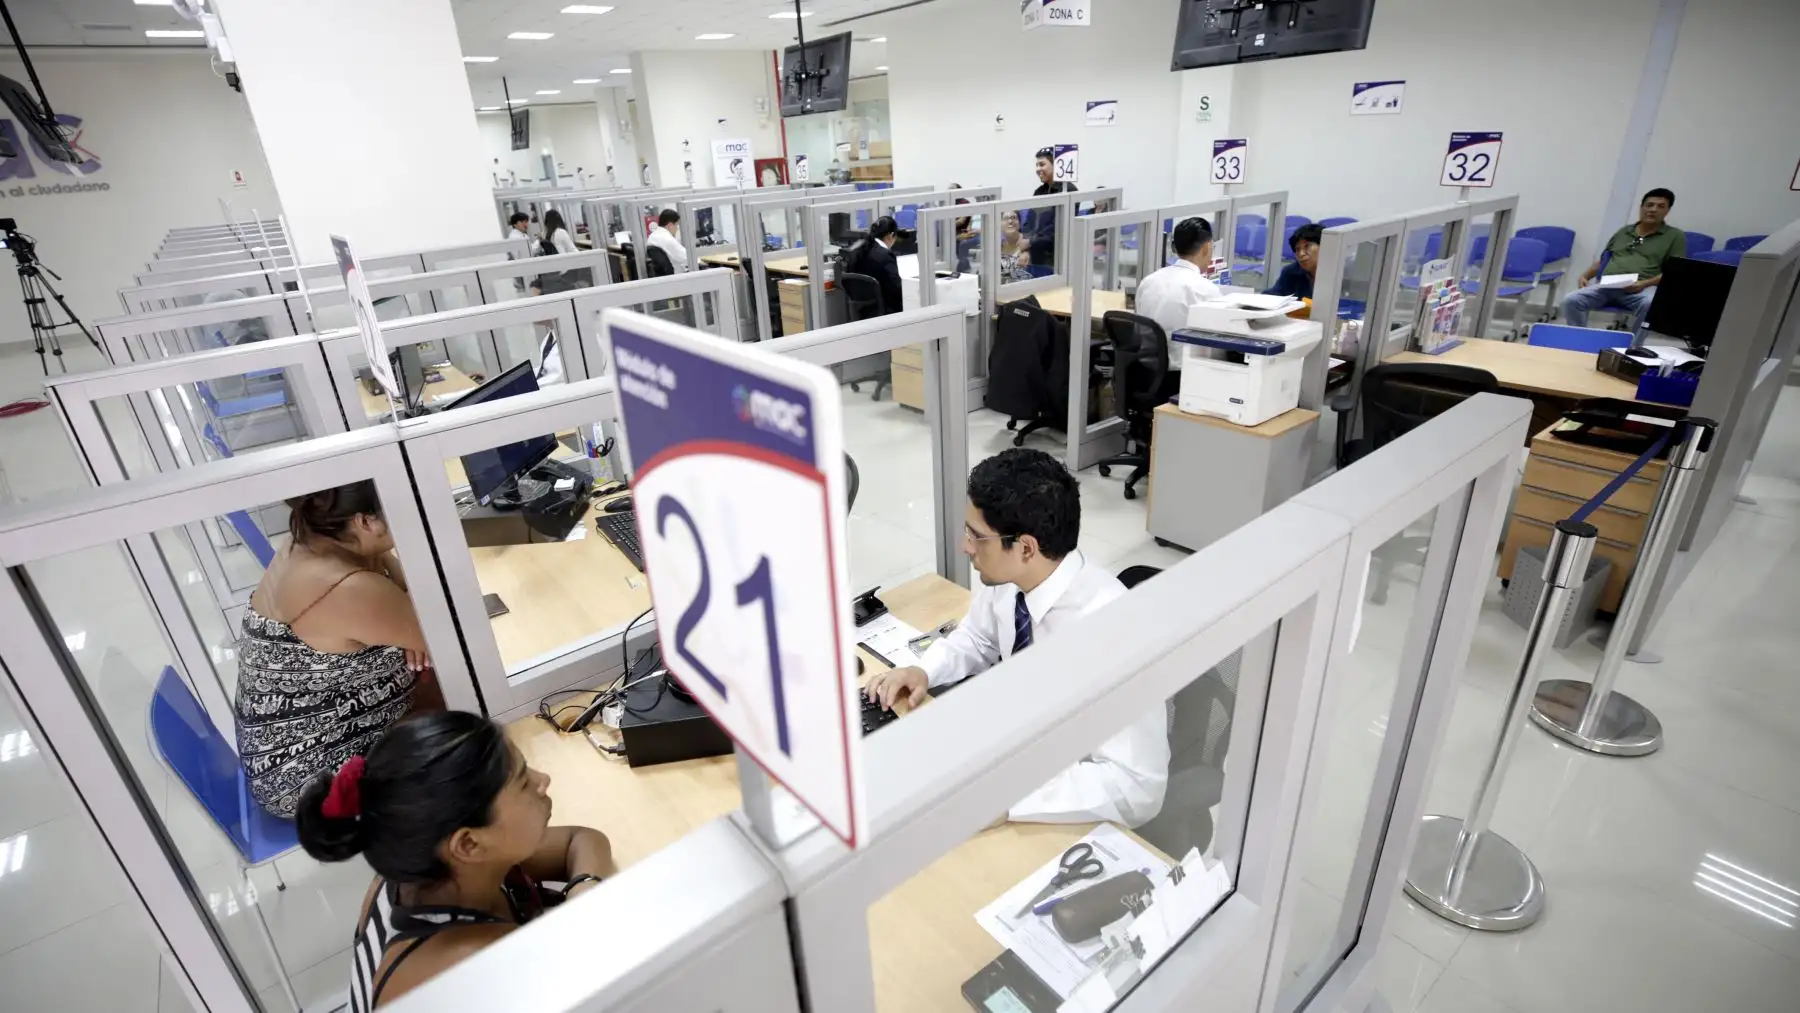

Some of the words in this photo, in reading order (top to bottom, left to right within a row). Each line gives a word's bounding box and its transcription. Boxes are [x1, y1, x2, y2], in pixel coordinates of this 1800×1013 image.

[1049, 8, 1073, 19] ZONA
[1077, 9, 1083, 20] C
[1200, 96, 1209, 111] S
[725, 143, 748, 152] mac
[1056, 158, 1074, 178] 34
[1215, 156, 1240, 180] 33
[1449, 152, 1490, 182] 32
[28, 181, 110, 196] ciudadano
[750, 389, 807, 440] mac
[655, 493, 793, 760] 21
